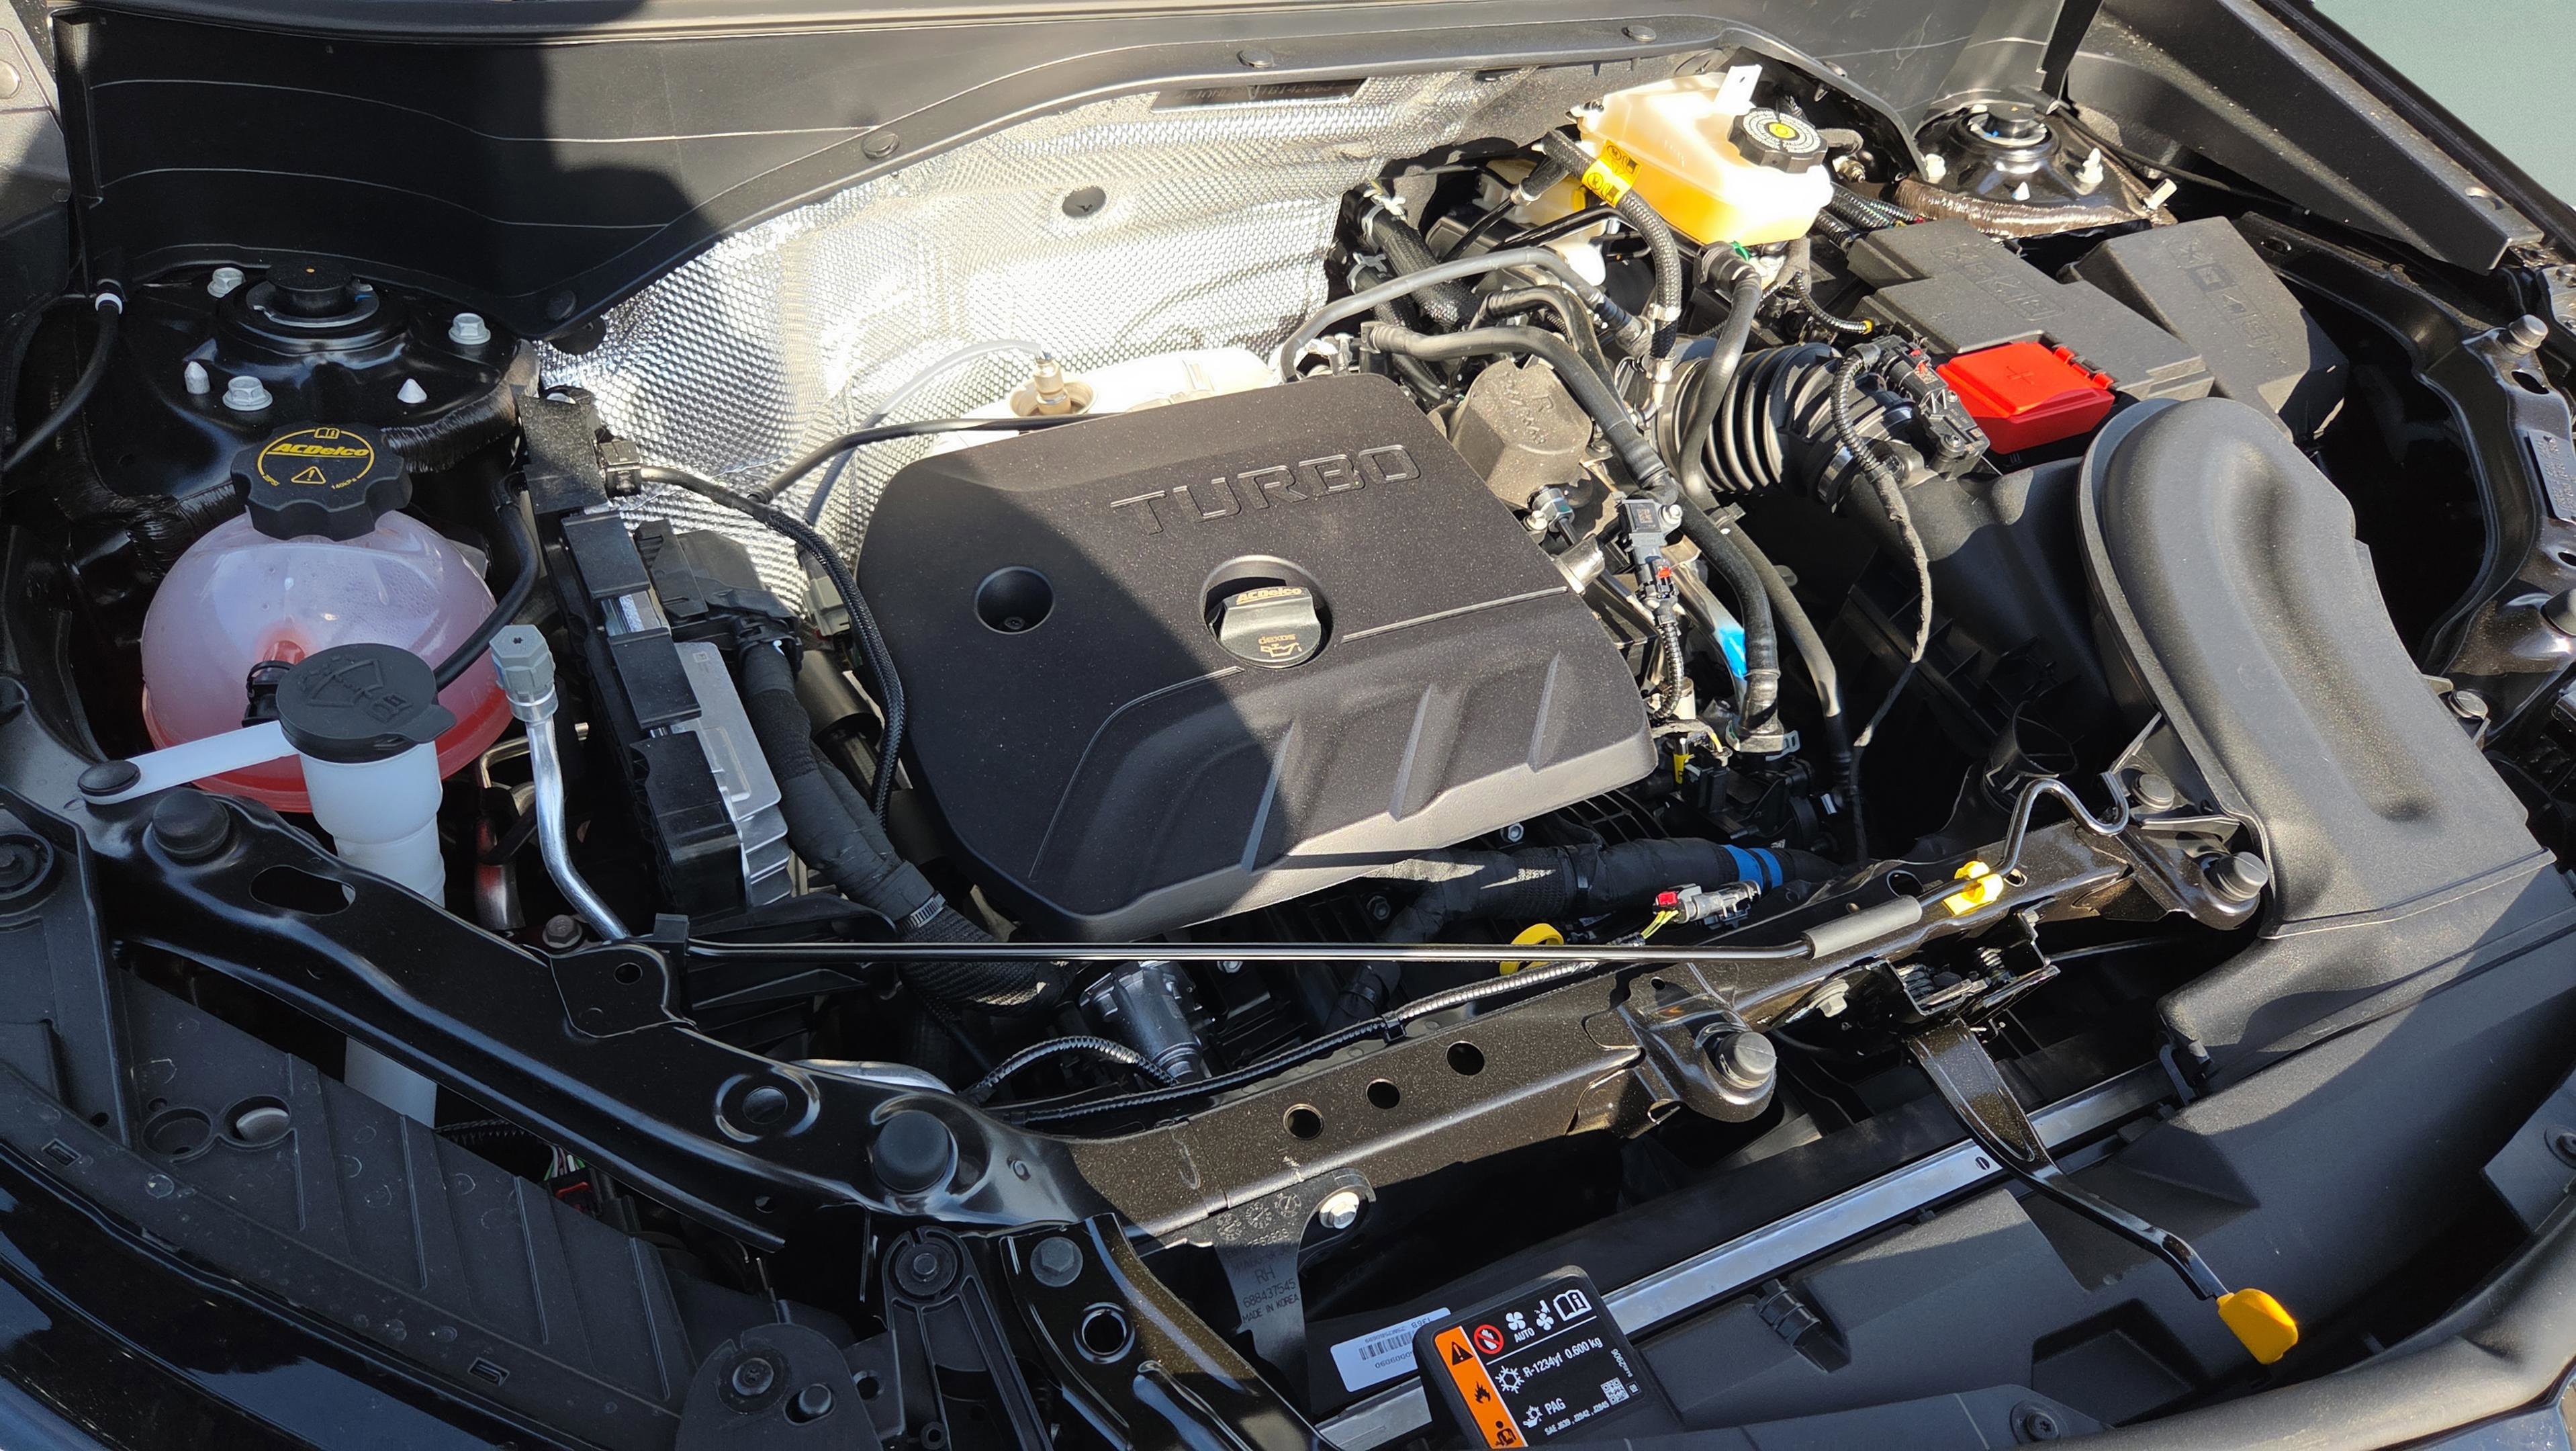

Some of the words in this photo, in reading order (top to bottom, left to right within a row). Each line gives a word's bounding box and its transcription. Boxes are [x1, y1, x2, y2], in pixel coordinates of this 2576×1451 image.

[272, 443, 369, 456] ACDelco
[1110, 444, 1421, 535] TURBO
[1236, 588, 1302, 605] ACDelco
[1254, 1265, 1276, 1284] RH
[1242, 1278, 1296, 1309] 688437545
[1242, 1307, 1262, 1324] MADE
[1266, 1303, 1275, 1313] IN
[1277, 1294, 1299, 1309] KOREA
[1514, 1327, 1536, 1343] AUTO
[1522, 1352, 1563, 1378] R-1234yf
[1564, 1342, 1590, 1359] 0.600
[1588, 1337, 1604, 1351] kg
[1545, 1397, 1566, 1415] PAG
[1544, 1424, 1558, 1436] SAE
